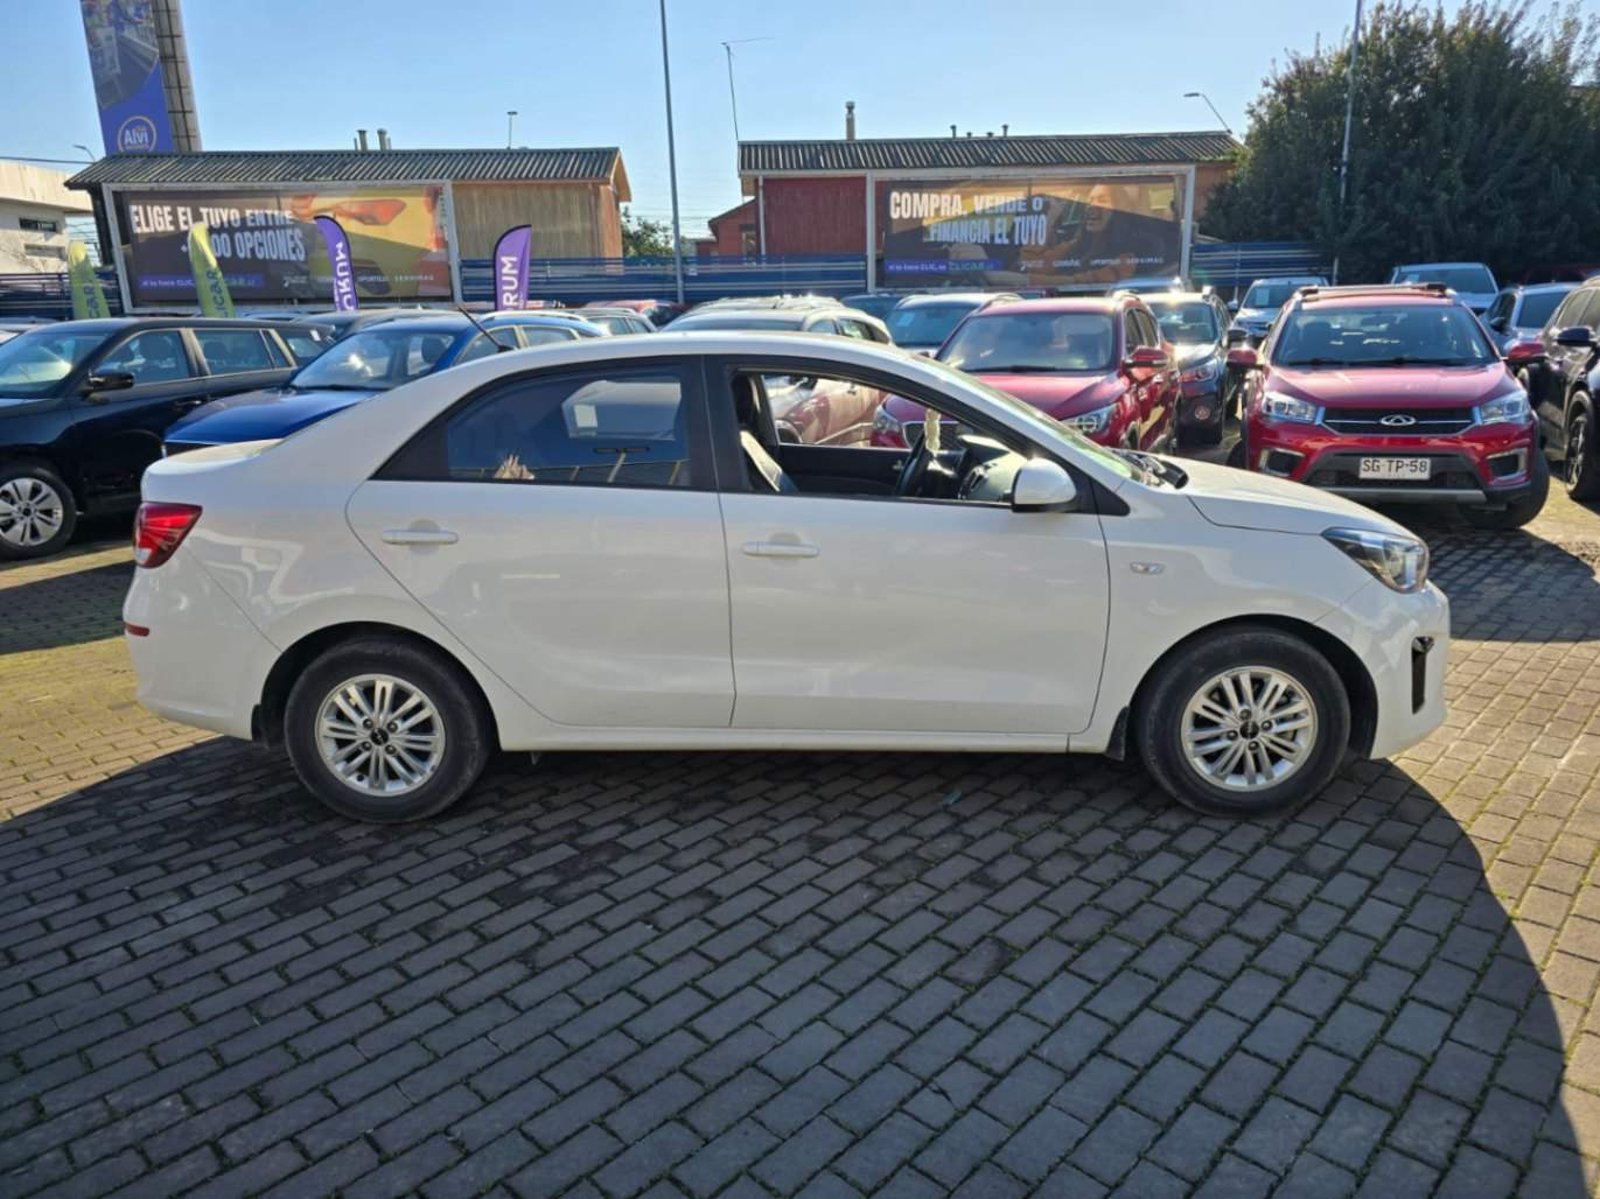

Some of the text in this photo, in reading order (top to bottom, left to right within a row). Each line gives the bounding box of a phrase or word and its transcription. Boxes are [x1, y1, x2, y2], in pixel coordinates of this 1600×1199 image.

[129, 205, 294, 234] ELIGE EL TUYO ENTRE
[974, 195, 1027, 214] VENDE
[234, 228, 305, 262] OPCIONES
[930, 214, 1047, 246] FINANCIA EL TUYO
[500, 256, 519, 311] RUM
